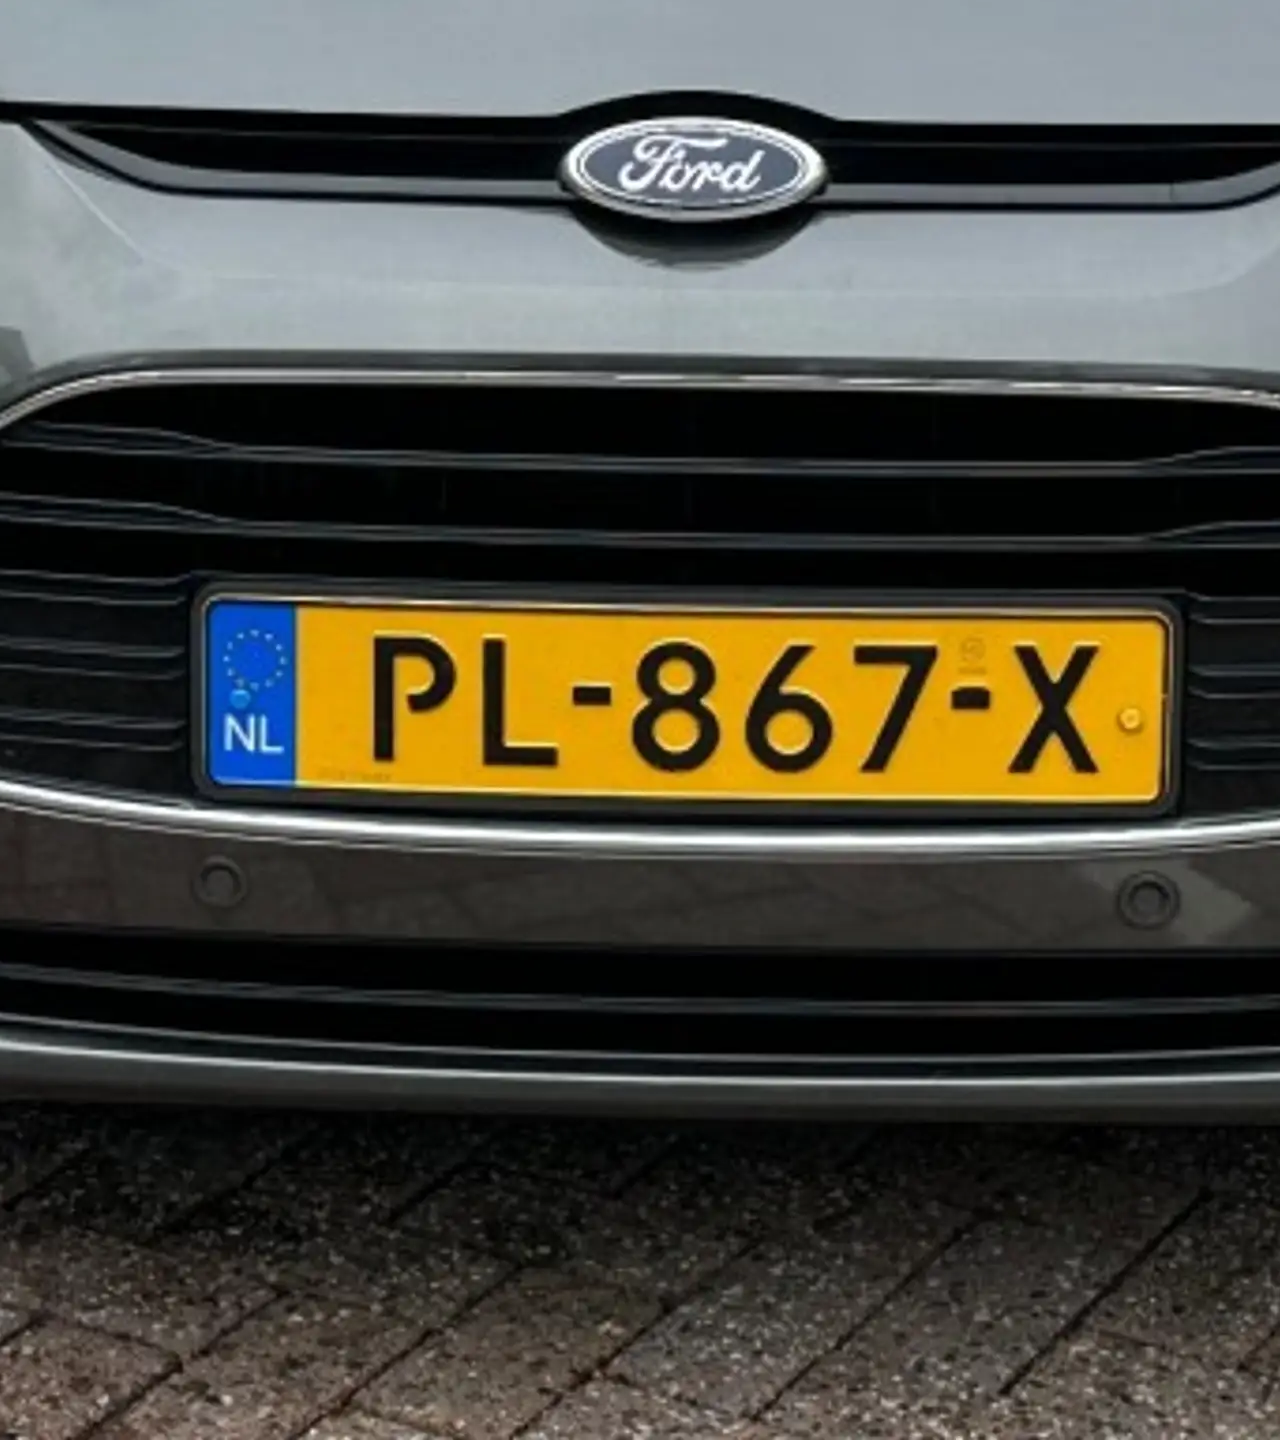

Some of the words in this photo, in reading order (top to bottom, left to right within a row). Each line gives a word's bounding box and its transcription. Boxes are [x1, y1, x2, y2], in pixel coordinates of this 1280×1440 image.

[617, 133, 766, 194] Ford
[223, 713, 285, 754] NL
[373, 636, 1098, 773] PL-867-X
